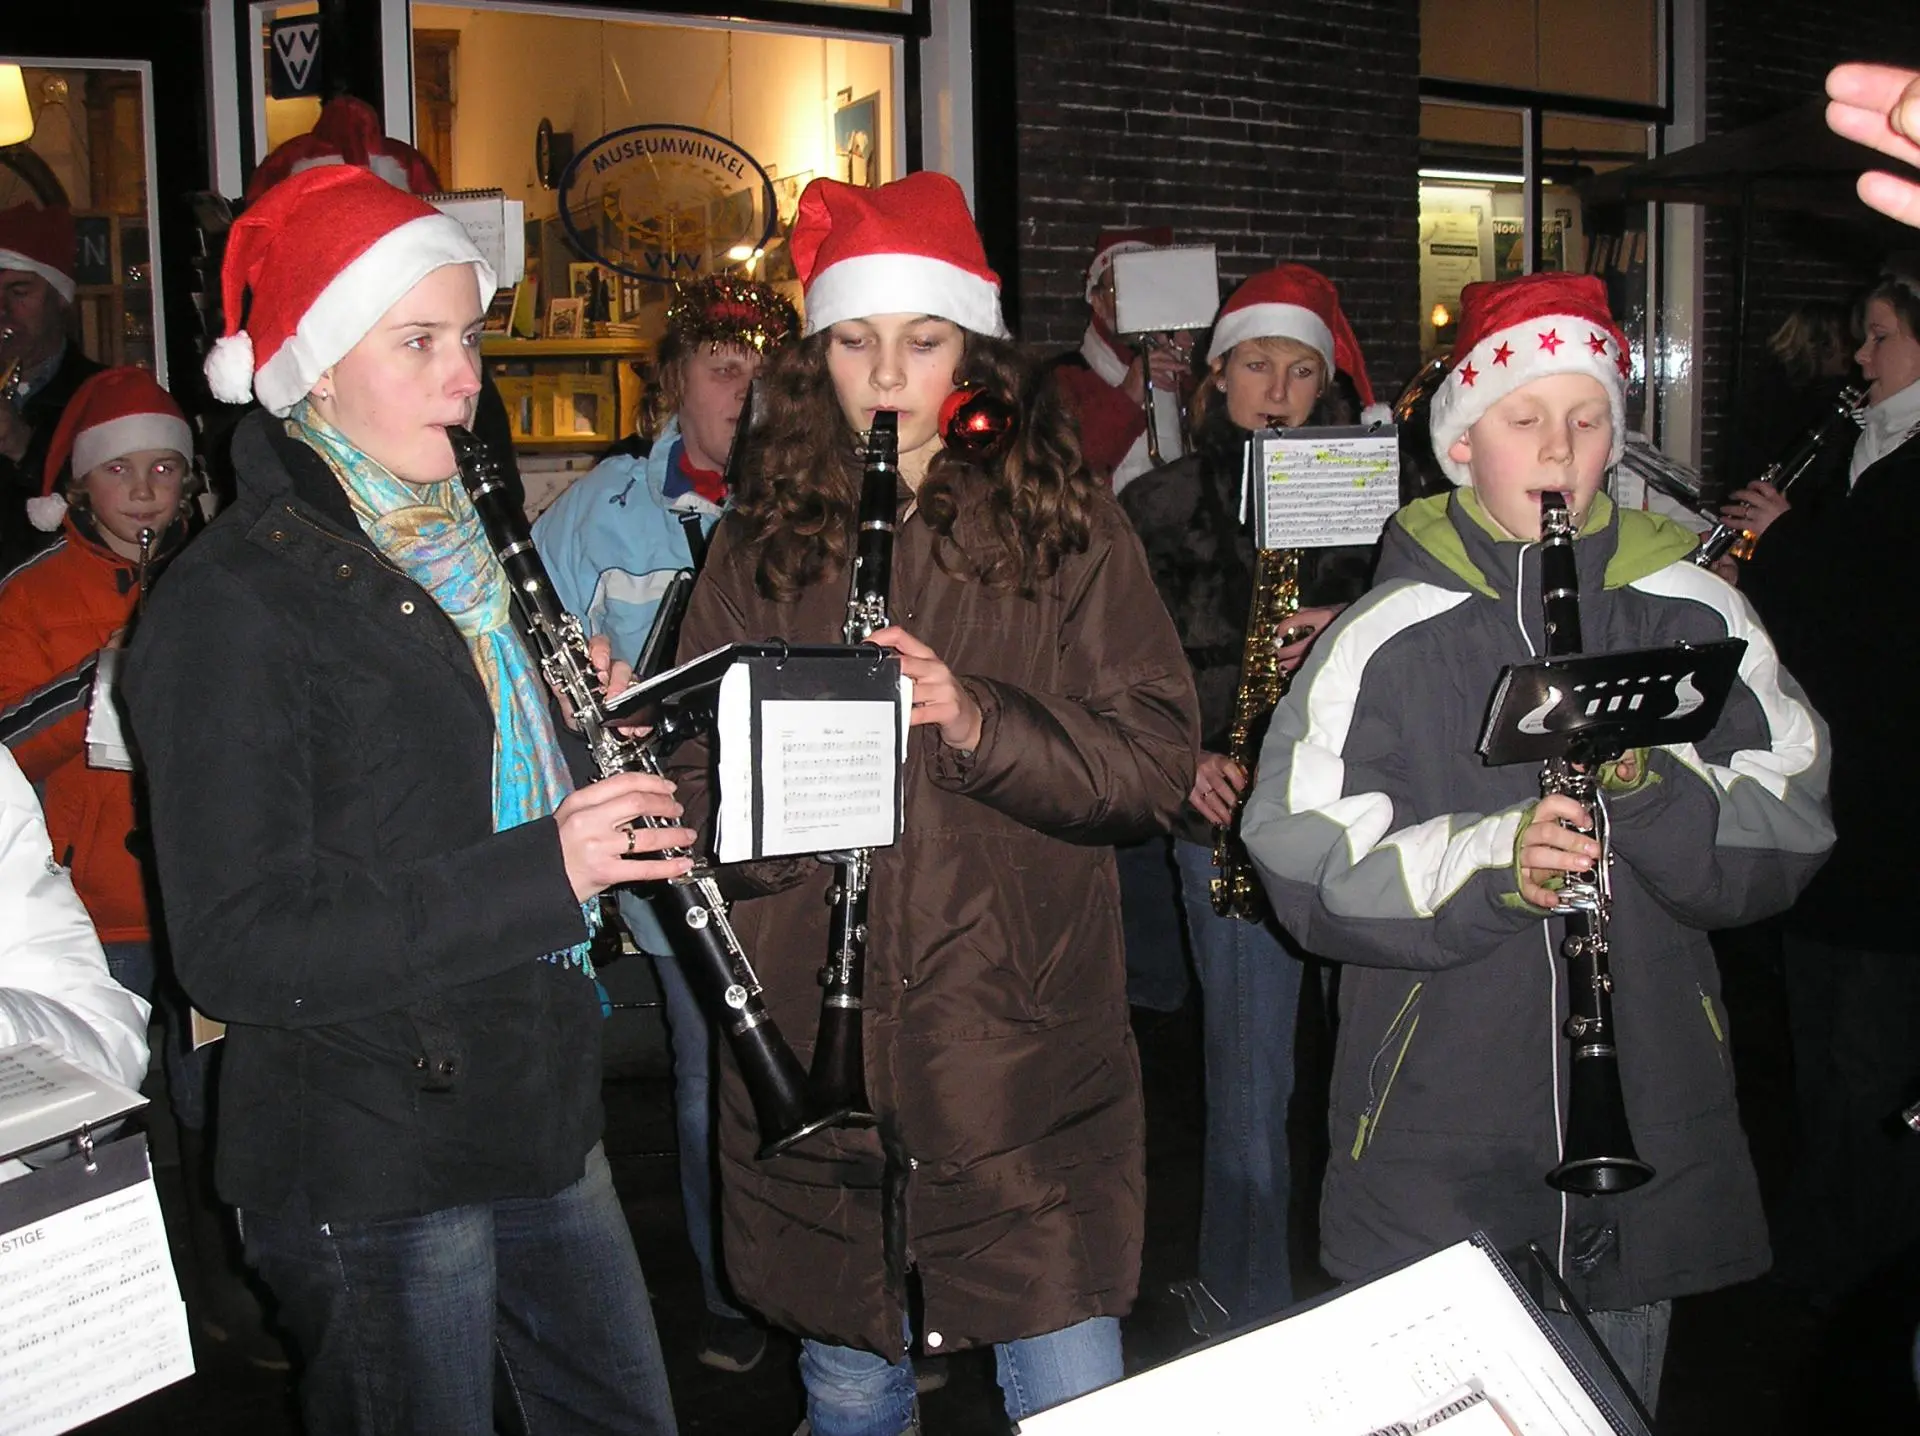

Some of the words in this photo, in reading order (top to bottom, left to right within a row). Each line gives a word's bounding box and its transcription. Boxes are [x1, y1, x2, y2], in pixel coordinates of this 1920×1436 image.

[592, 137, 745, 180] MUSEUMWINKEL
[643, 252, 701, 272] VVV
[0, 1227, 46, 1255] STIGE
